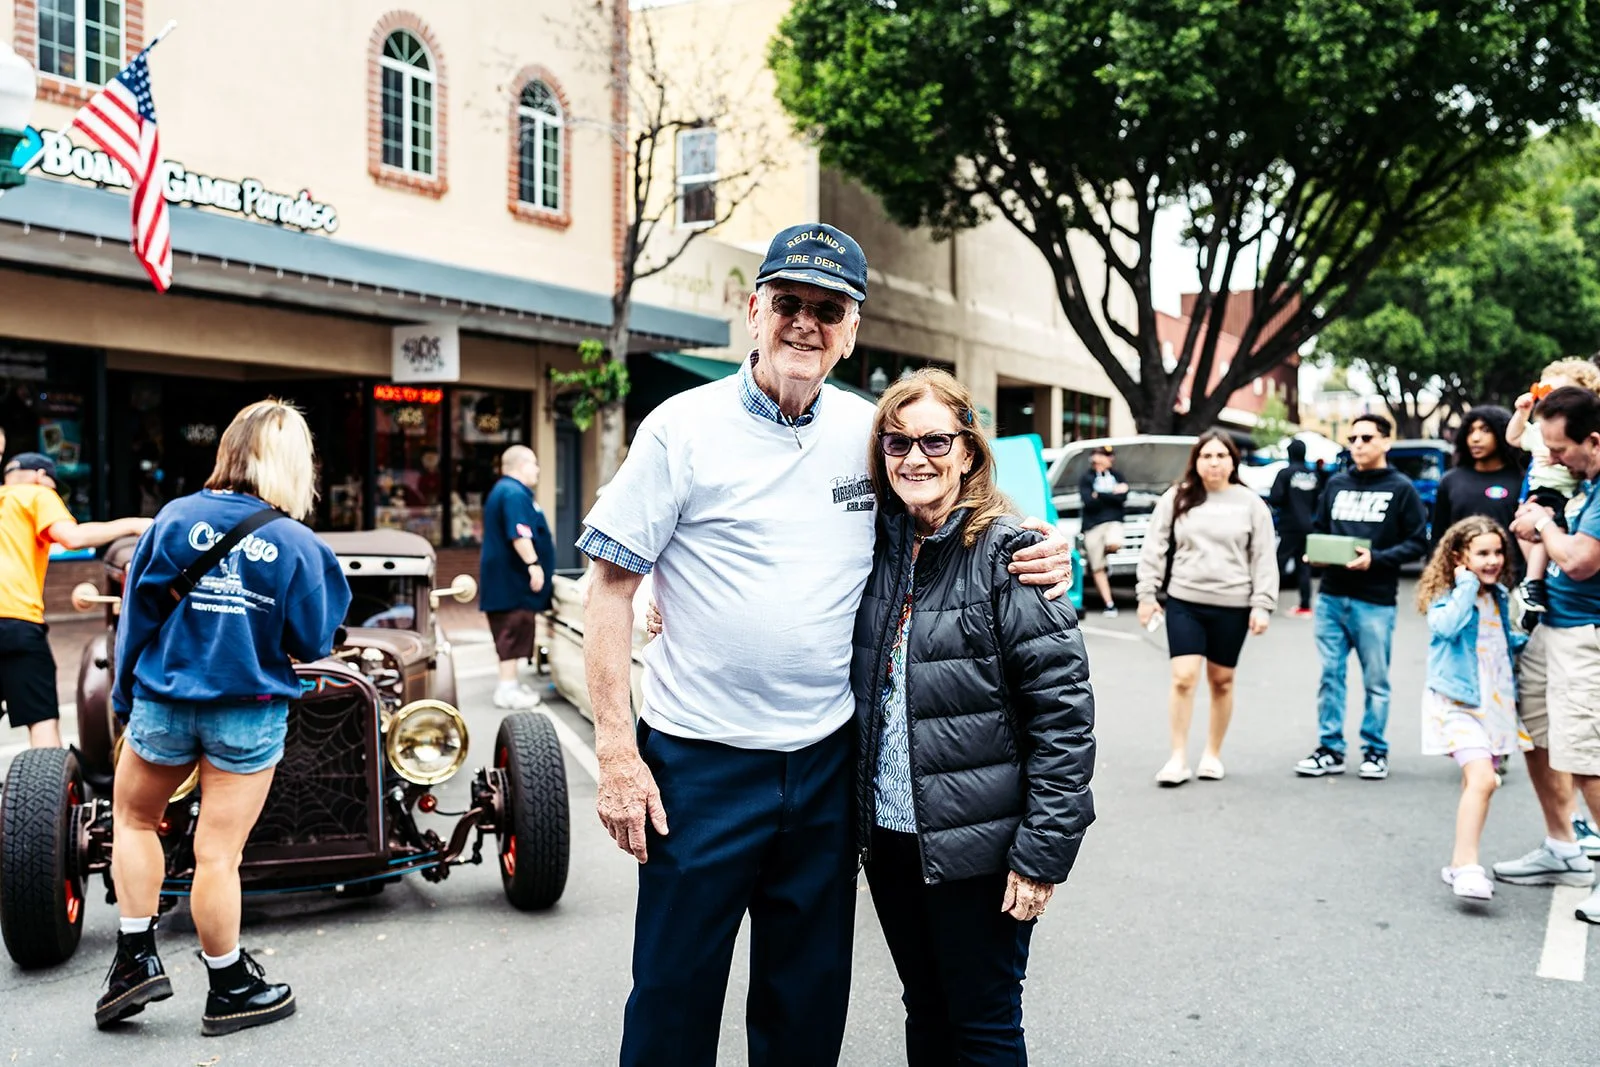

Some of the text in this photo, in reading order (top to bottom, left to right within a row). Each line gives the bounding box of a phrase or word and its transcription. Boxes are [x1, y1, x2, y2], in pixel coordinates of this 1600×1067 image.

[40, 128, 340, 234] BOAR GAME Paradise
[786, 230, 847, 255] REDLANDS
[785, 254, 845, 275] FIRE DEPT.
[832, 479, 876, 504] FIREFIGHT
[846, 501, 860, 511] CAR
[1331, 489, 1394, 523] NIKE
